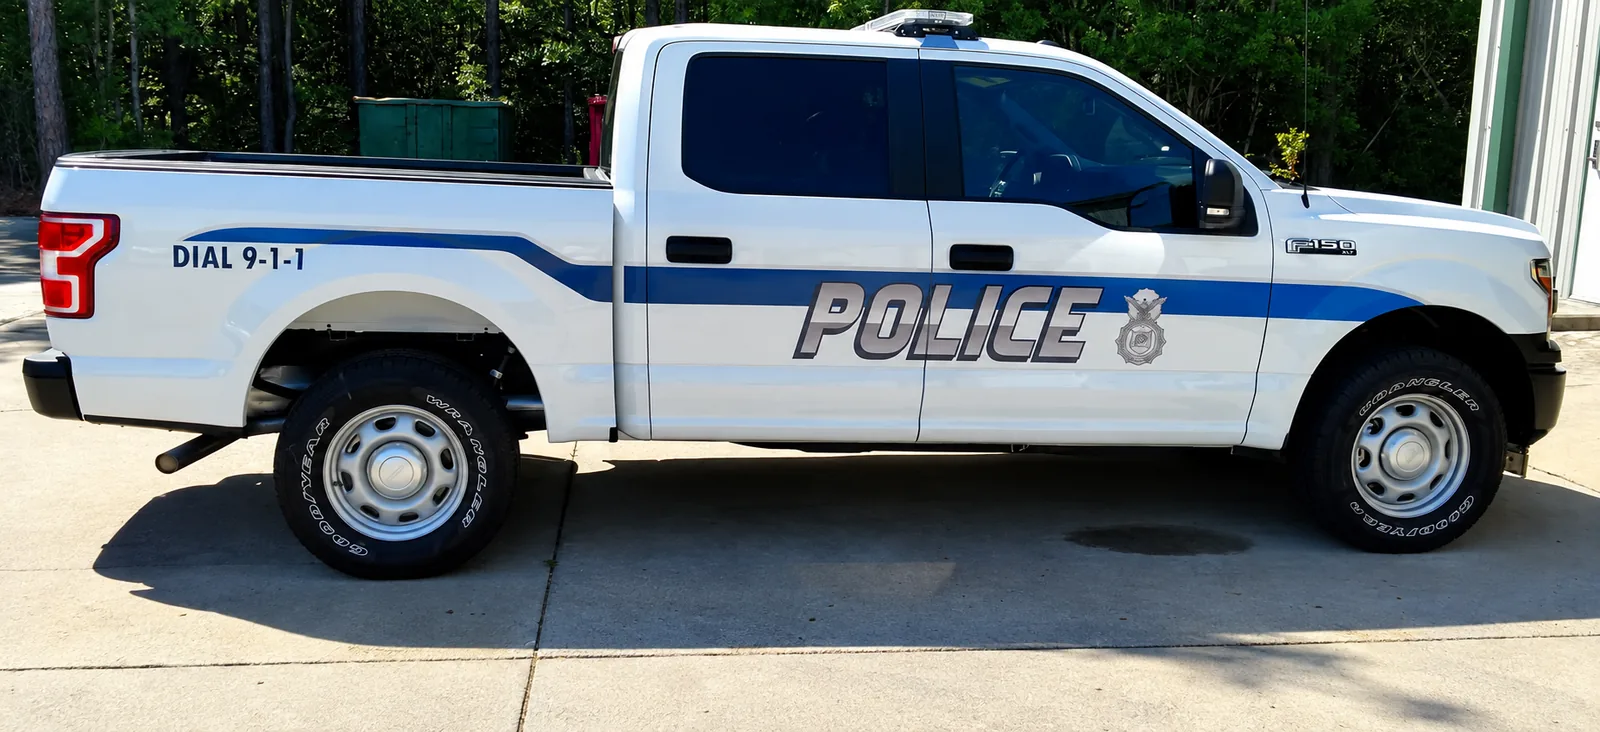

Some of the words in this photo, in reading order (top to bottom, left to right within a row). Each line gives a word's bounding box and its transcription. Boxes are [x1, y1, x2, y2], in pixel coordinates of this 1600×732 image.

[172, 244, 233, 269] DIAL
[242, 246, 304, 270] 9-1-1
[792, 281, 1104, 364] POLICE
[1358, 377, 1480, 417] WRANGLER
[426, 394, 488, 529] WRANGLER
